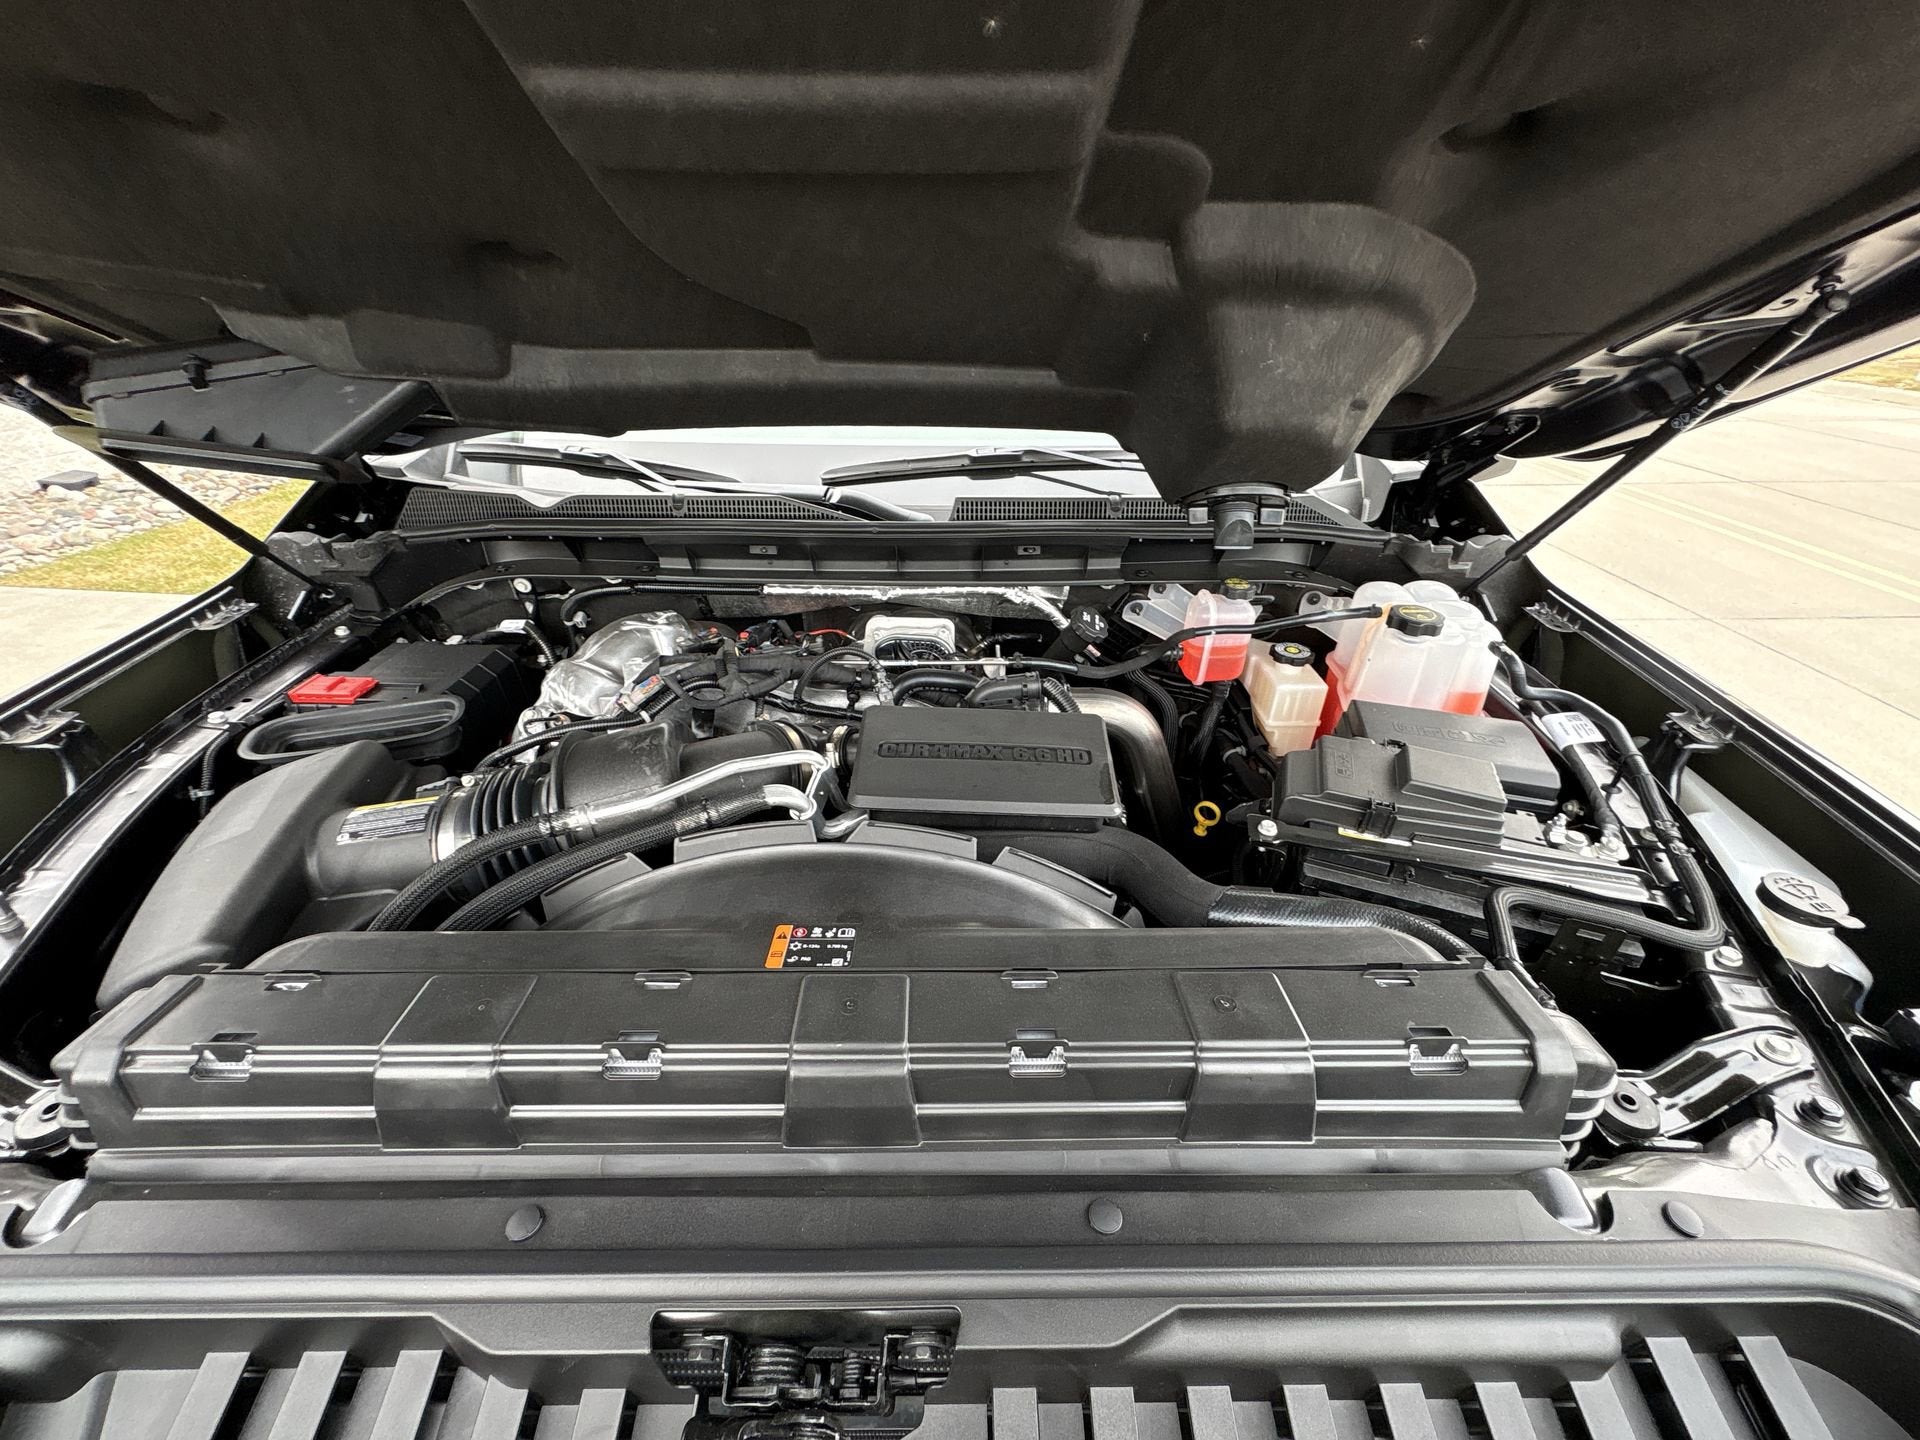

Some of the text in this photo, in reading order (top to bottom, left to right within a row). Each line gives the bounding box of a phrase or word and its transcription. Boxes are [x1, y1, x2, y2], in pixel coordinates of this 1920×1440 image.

[880, 743, 1091, 764] DURAMAX 6.6 HD
